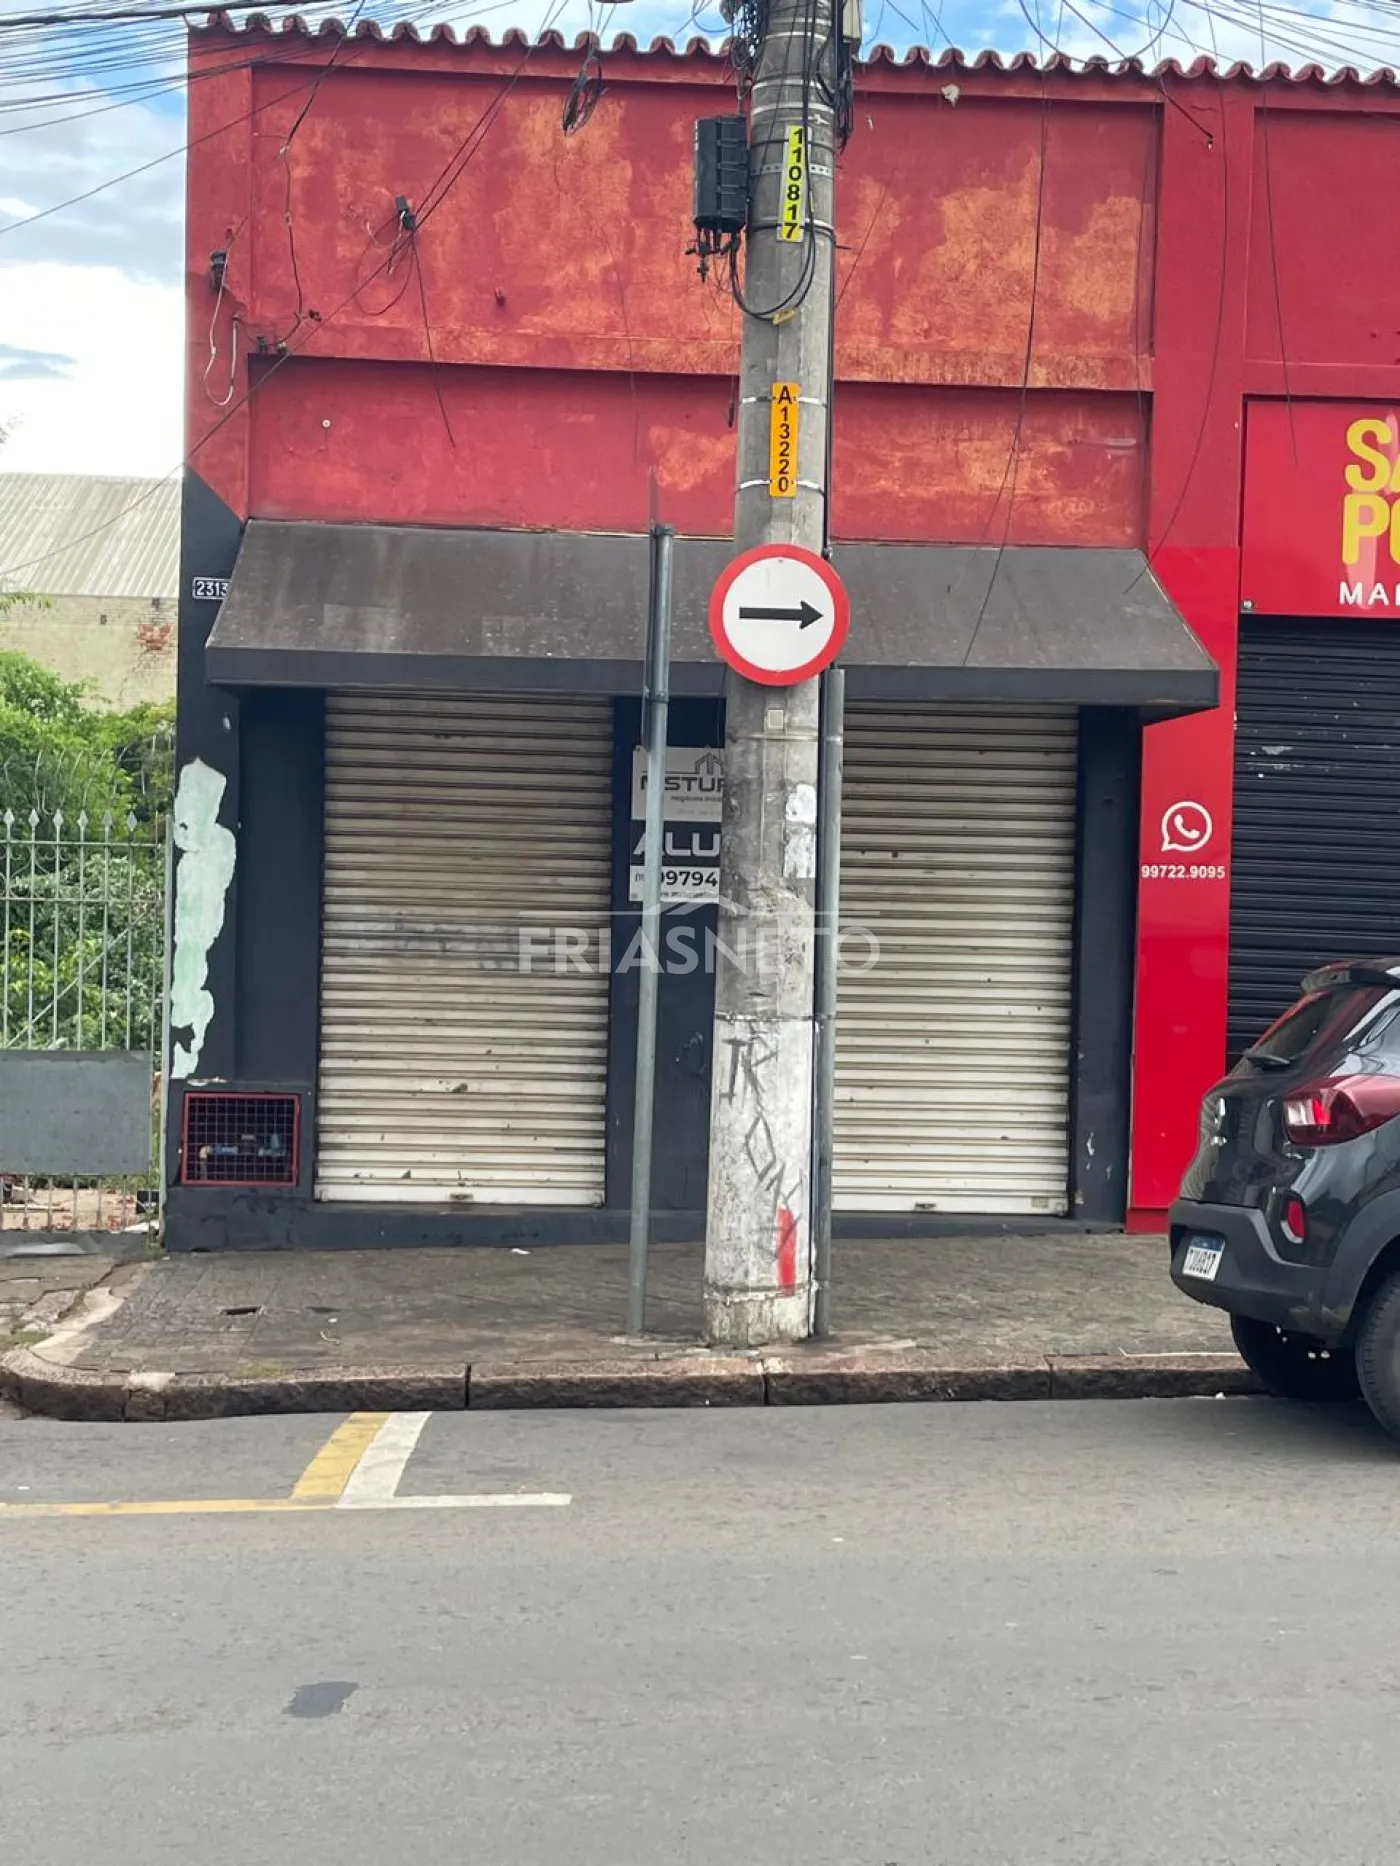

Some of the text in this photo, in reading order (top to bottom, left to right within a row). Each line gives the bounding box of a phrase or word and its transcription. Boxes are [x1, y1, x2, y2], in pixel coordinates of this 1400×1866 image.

[784, 128, 804, 239] 110817
[778, 385, 793, 492] A13220
[1344, 418, 1400, 493] S
[1342, 494, 1400, 566] P
[1141, 865, 1226, 879] 99722.9095
